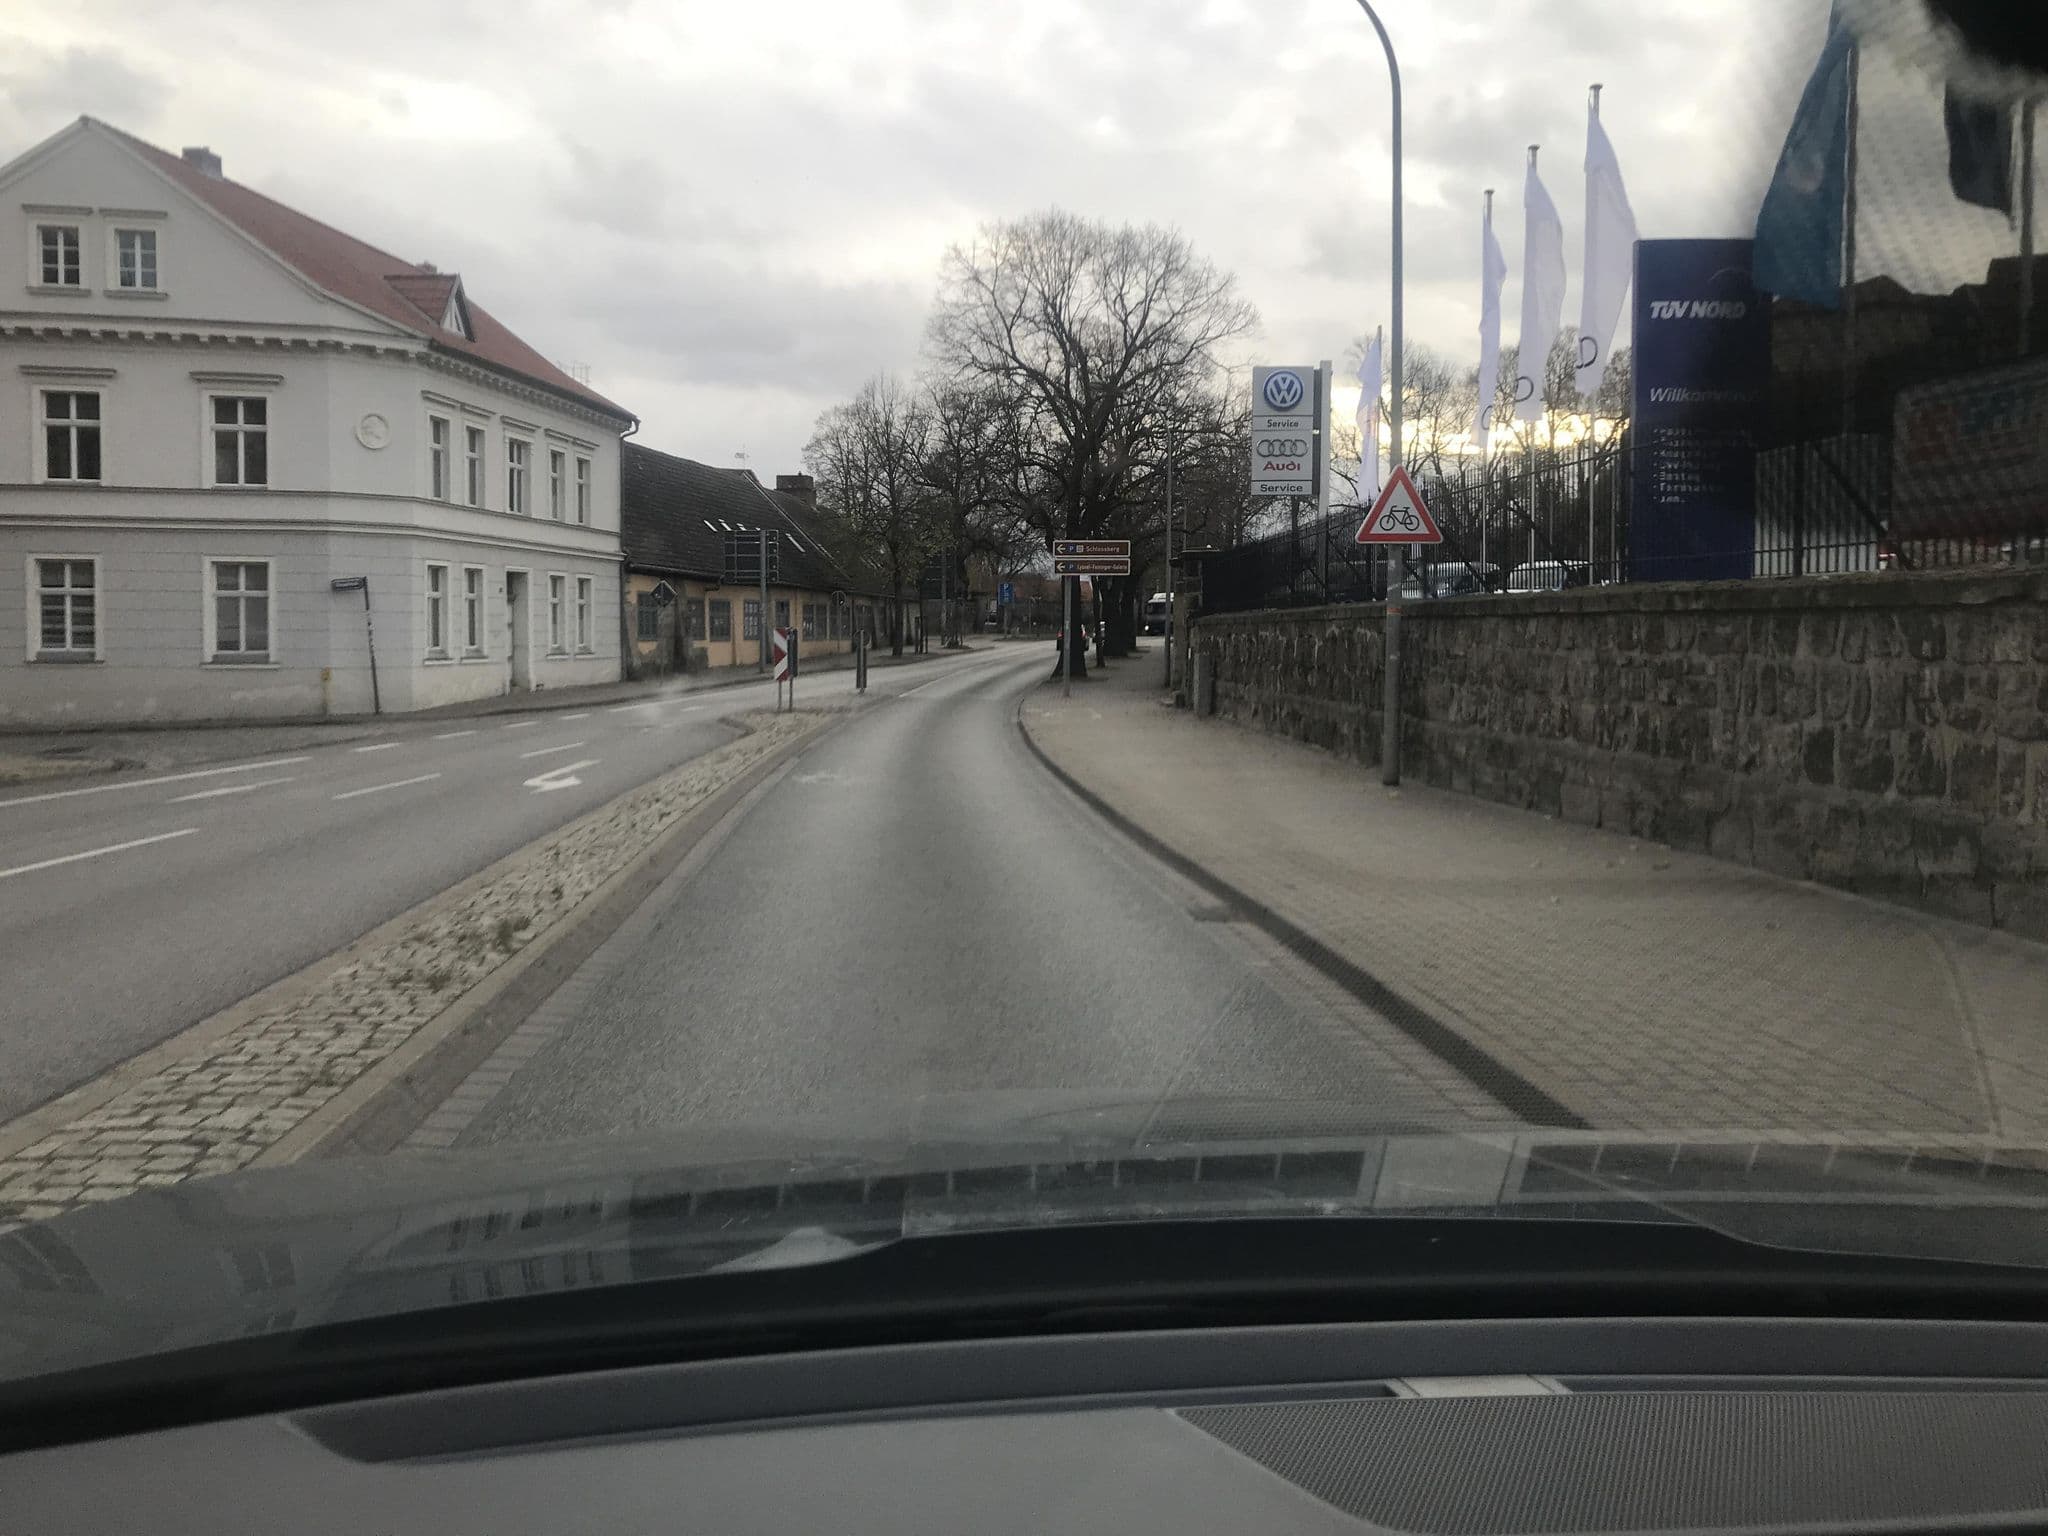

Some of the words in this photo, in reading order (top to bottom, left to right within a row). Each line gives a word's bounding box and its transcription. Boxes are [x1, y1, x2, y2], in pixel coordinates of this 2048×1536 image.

[1650, 300, 1690, 320] TÜV
[1689, 299, 1746, 320] NORD
[1267, 419, 1299, 428] Service
[1262, 460, 1301, 472] Audi
[1260, 483, 1303, 493] Service
